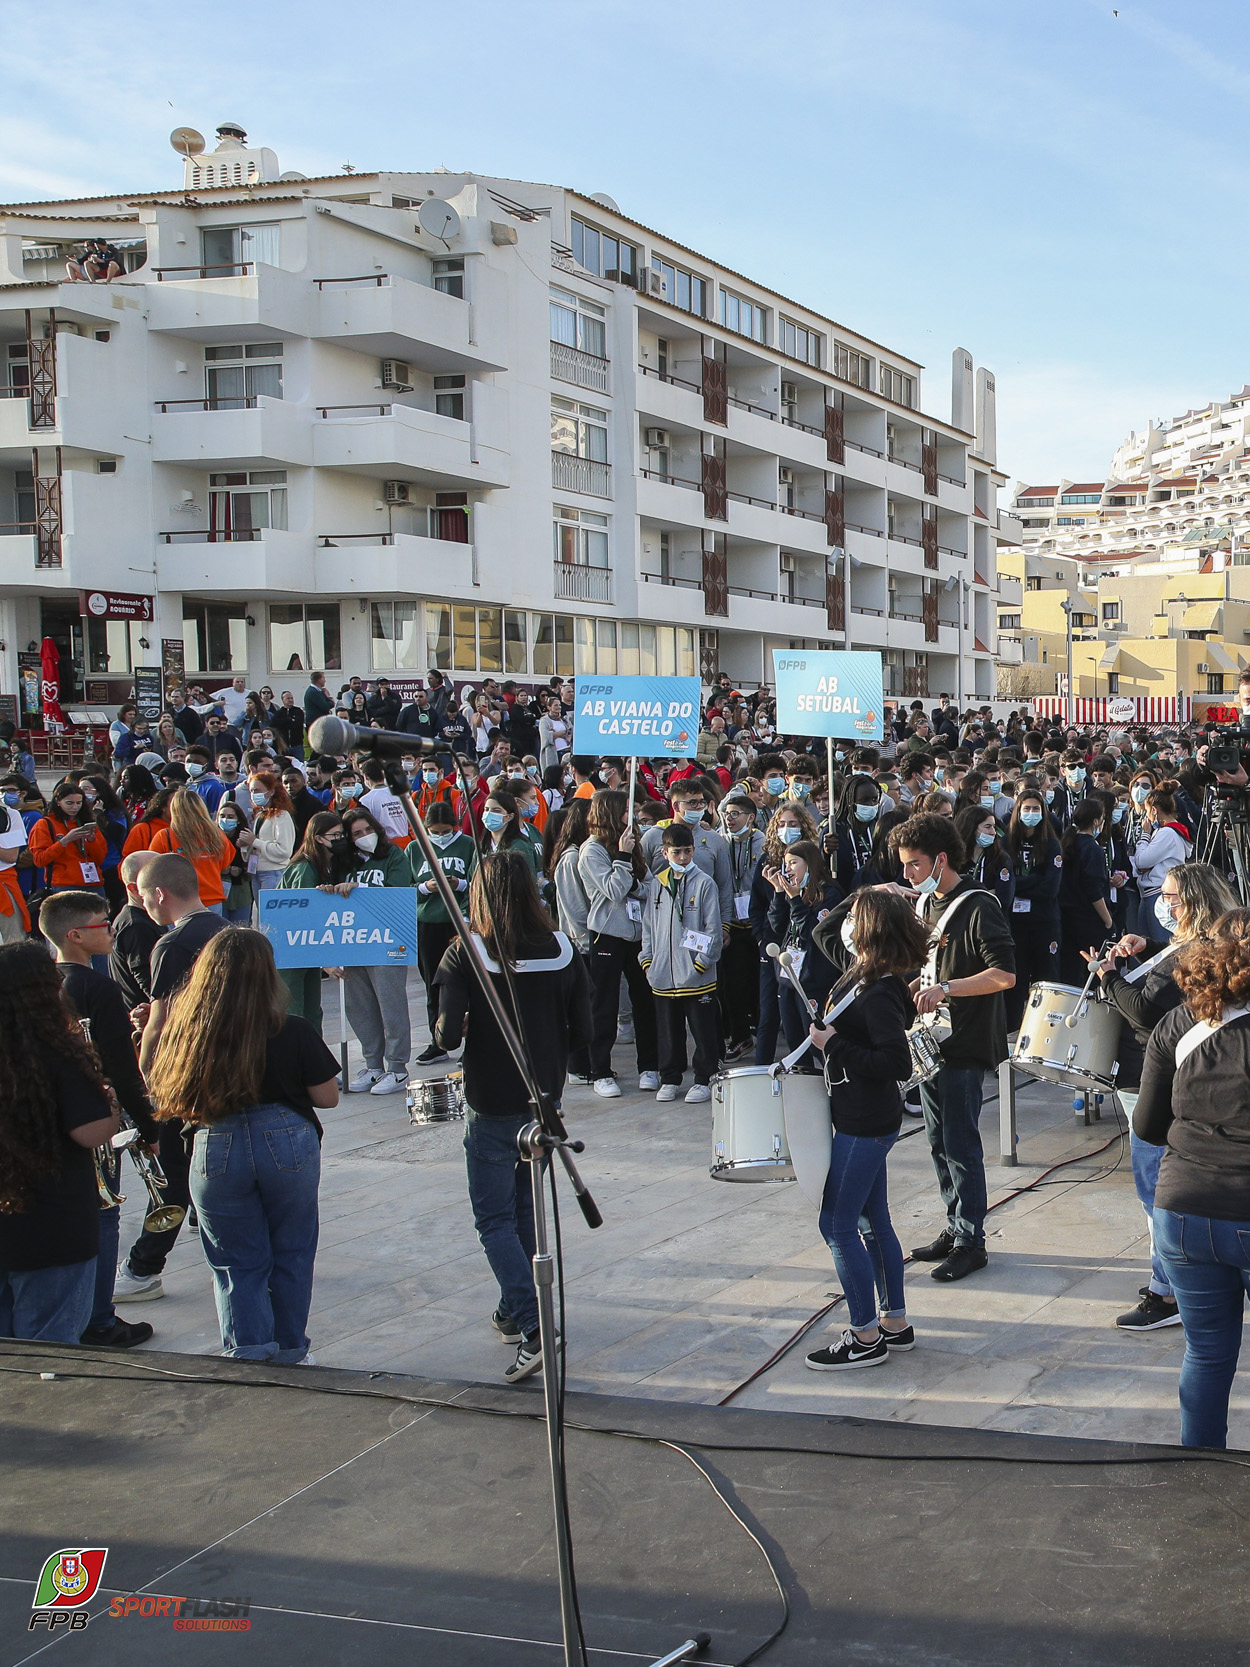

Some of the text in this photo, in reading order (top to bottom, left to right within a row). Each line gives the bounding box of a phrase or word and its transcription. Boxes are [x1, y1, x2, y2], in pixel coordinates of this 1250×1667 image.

[389, 683, 420, 691] taurante
[816, 676, 838, 693] AB
[581, 700, 693, 718] AB VIANA DO
[796, 690, 861, 714] SETÚBAL
[598, 718, 673, 736] CASTELO
[324, 911, 355, 927] AB
[286, 928, 394, 946] VILA REAL
